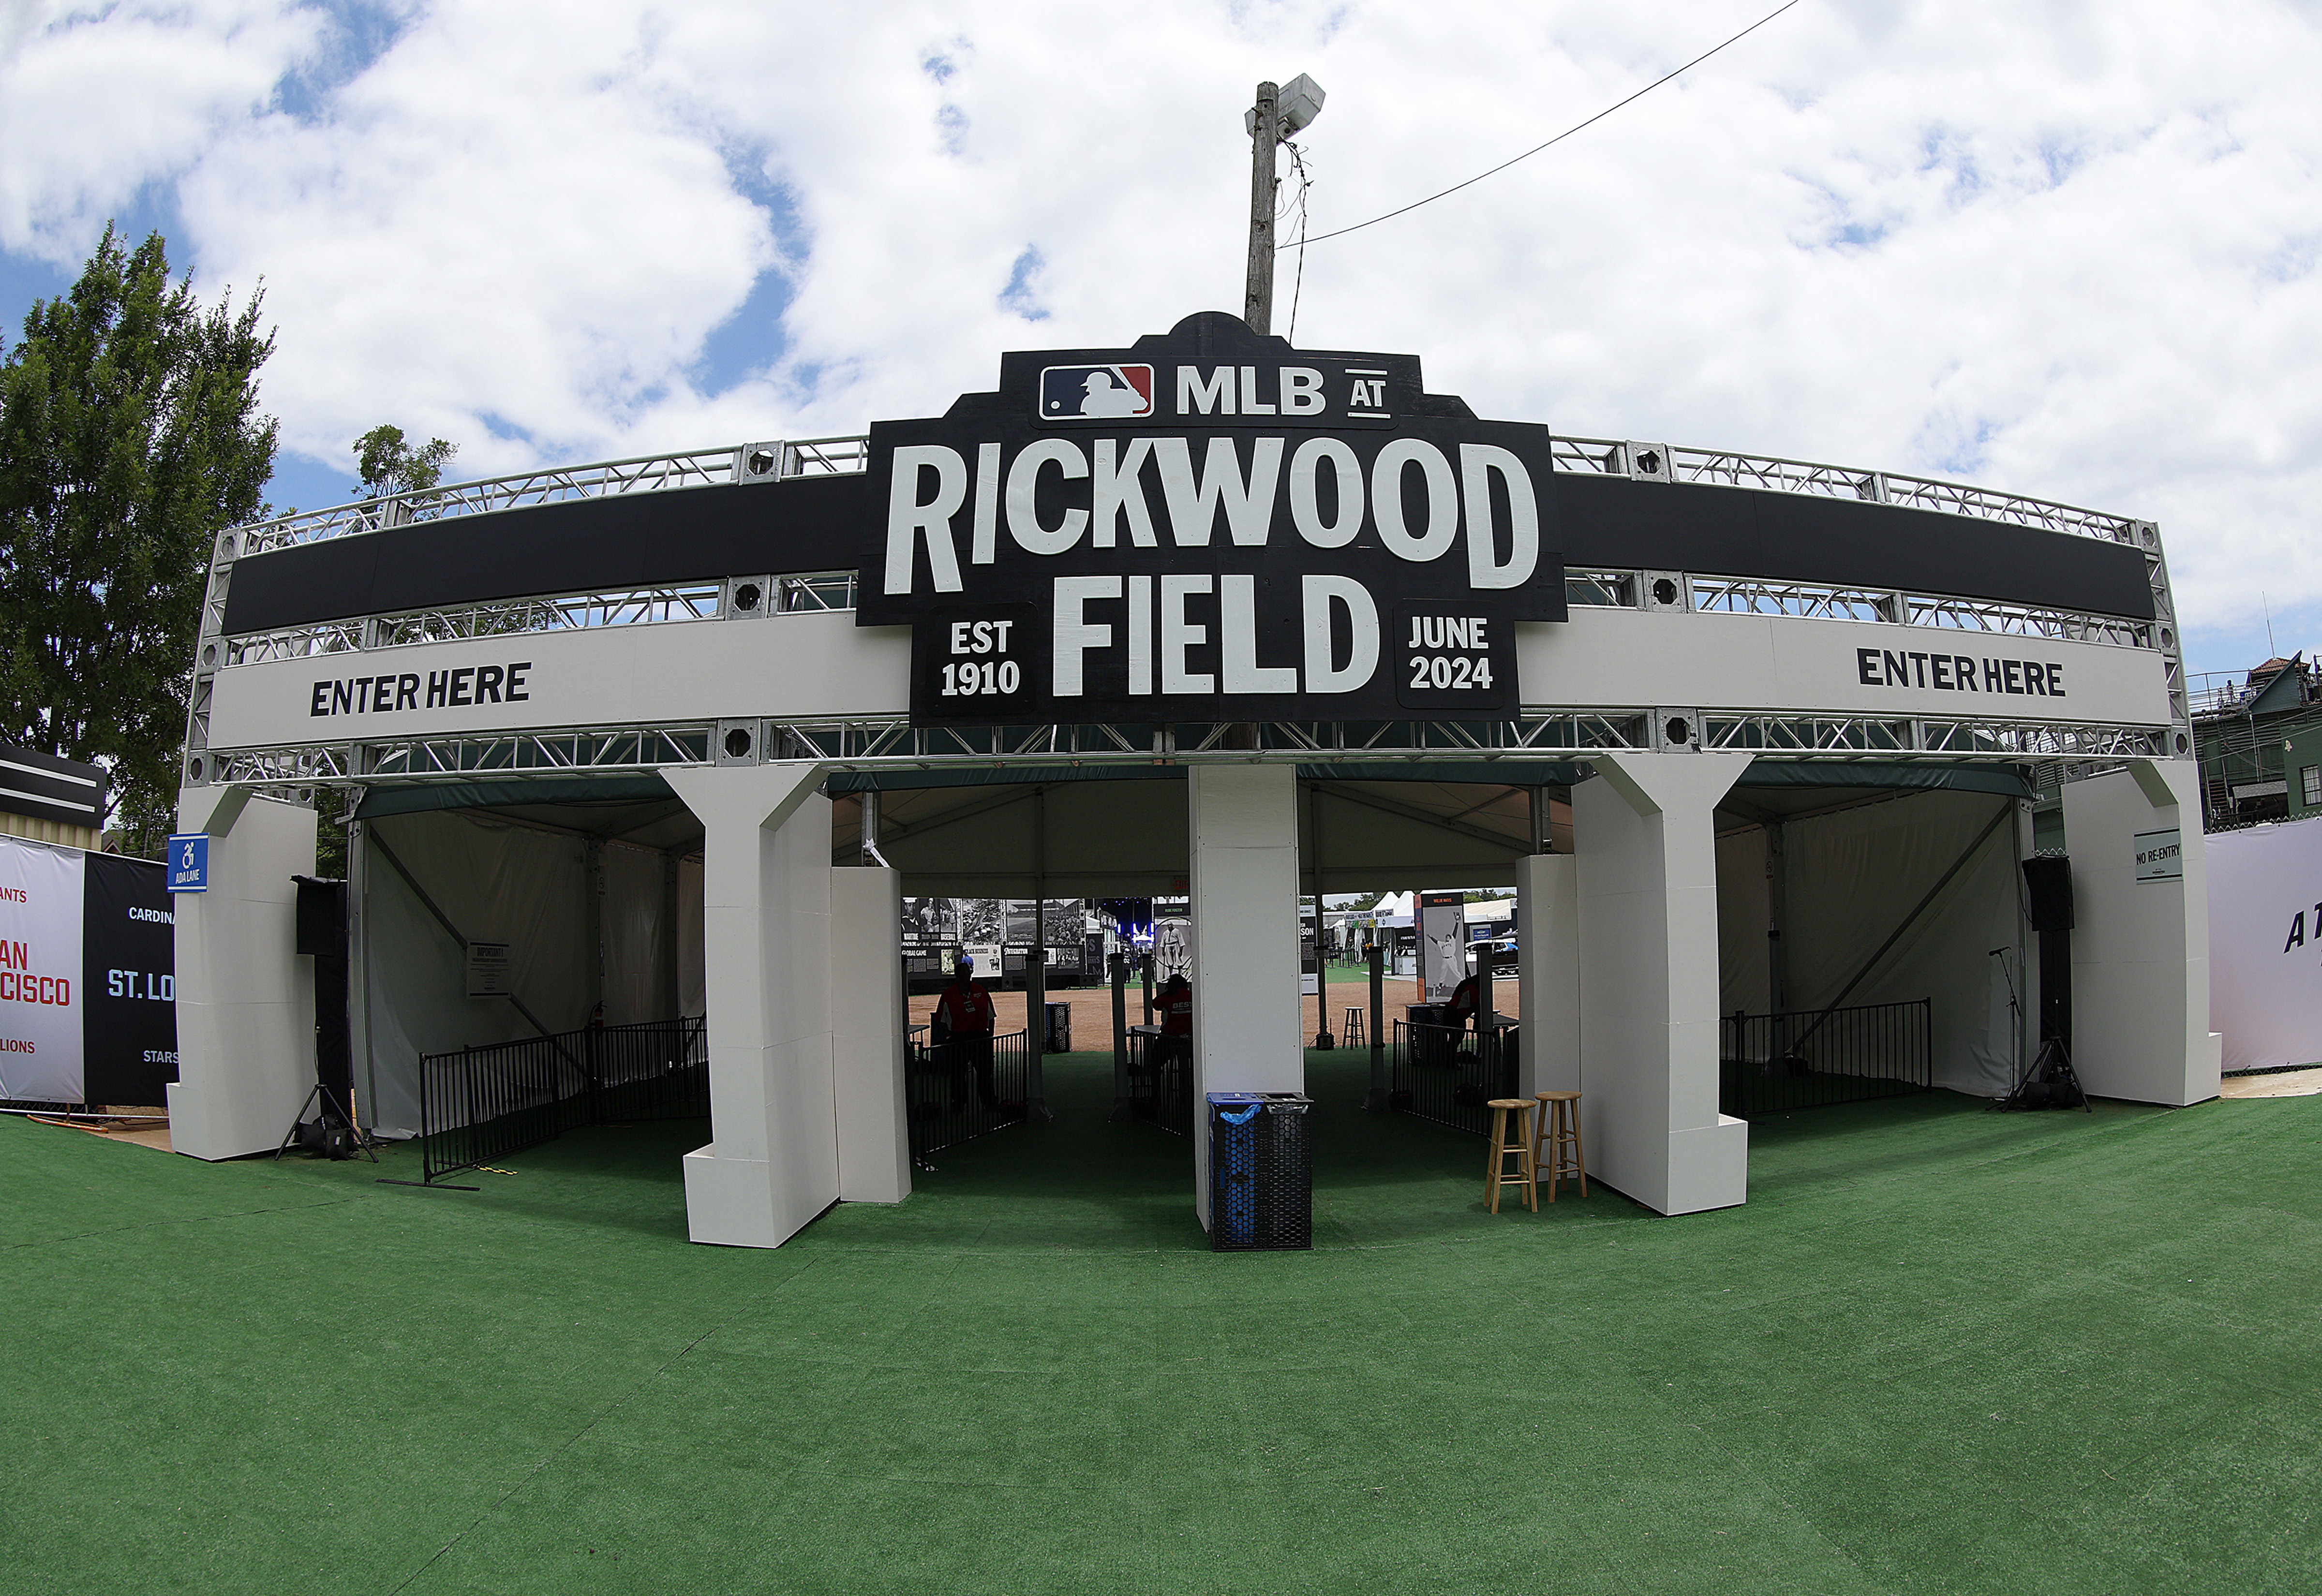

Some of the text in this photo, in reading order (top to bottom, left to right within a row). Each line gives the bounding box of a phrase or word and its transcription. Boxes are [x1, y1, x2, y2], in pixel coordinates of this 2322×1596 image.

[1176, 365, 1387, 416] MLB AT
[884, 437, 1540, 594] RICKWOOD
[951, 620, 1012, 654] EST
[1053, 574, 1380, 696] FIELD
[1410, 617, 1489, 650] JUNE
[310, 661, 532, 717] ENTER HERE
[941, 661, 1020, 696] 1910
[1410, 656, 1493, 691] 2024
[1856, 647, 2067, 697] ENTER HERE
[2136, 843, 2180, 866] NO RE-ENTRY
[175, 869, 200, 885] ADA LANE
[0, 971, 71, 1007] CISCO
[108, 969, 143, 999] ST.
[0, 1038, 35, 1054] LIONS
[143, 1050, 179, 1064] STARS
